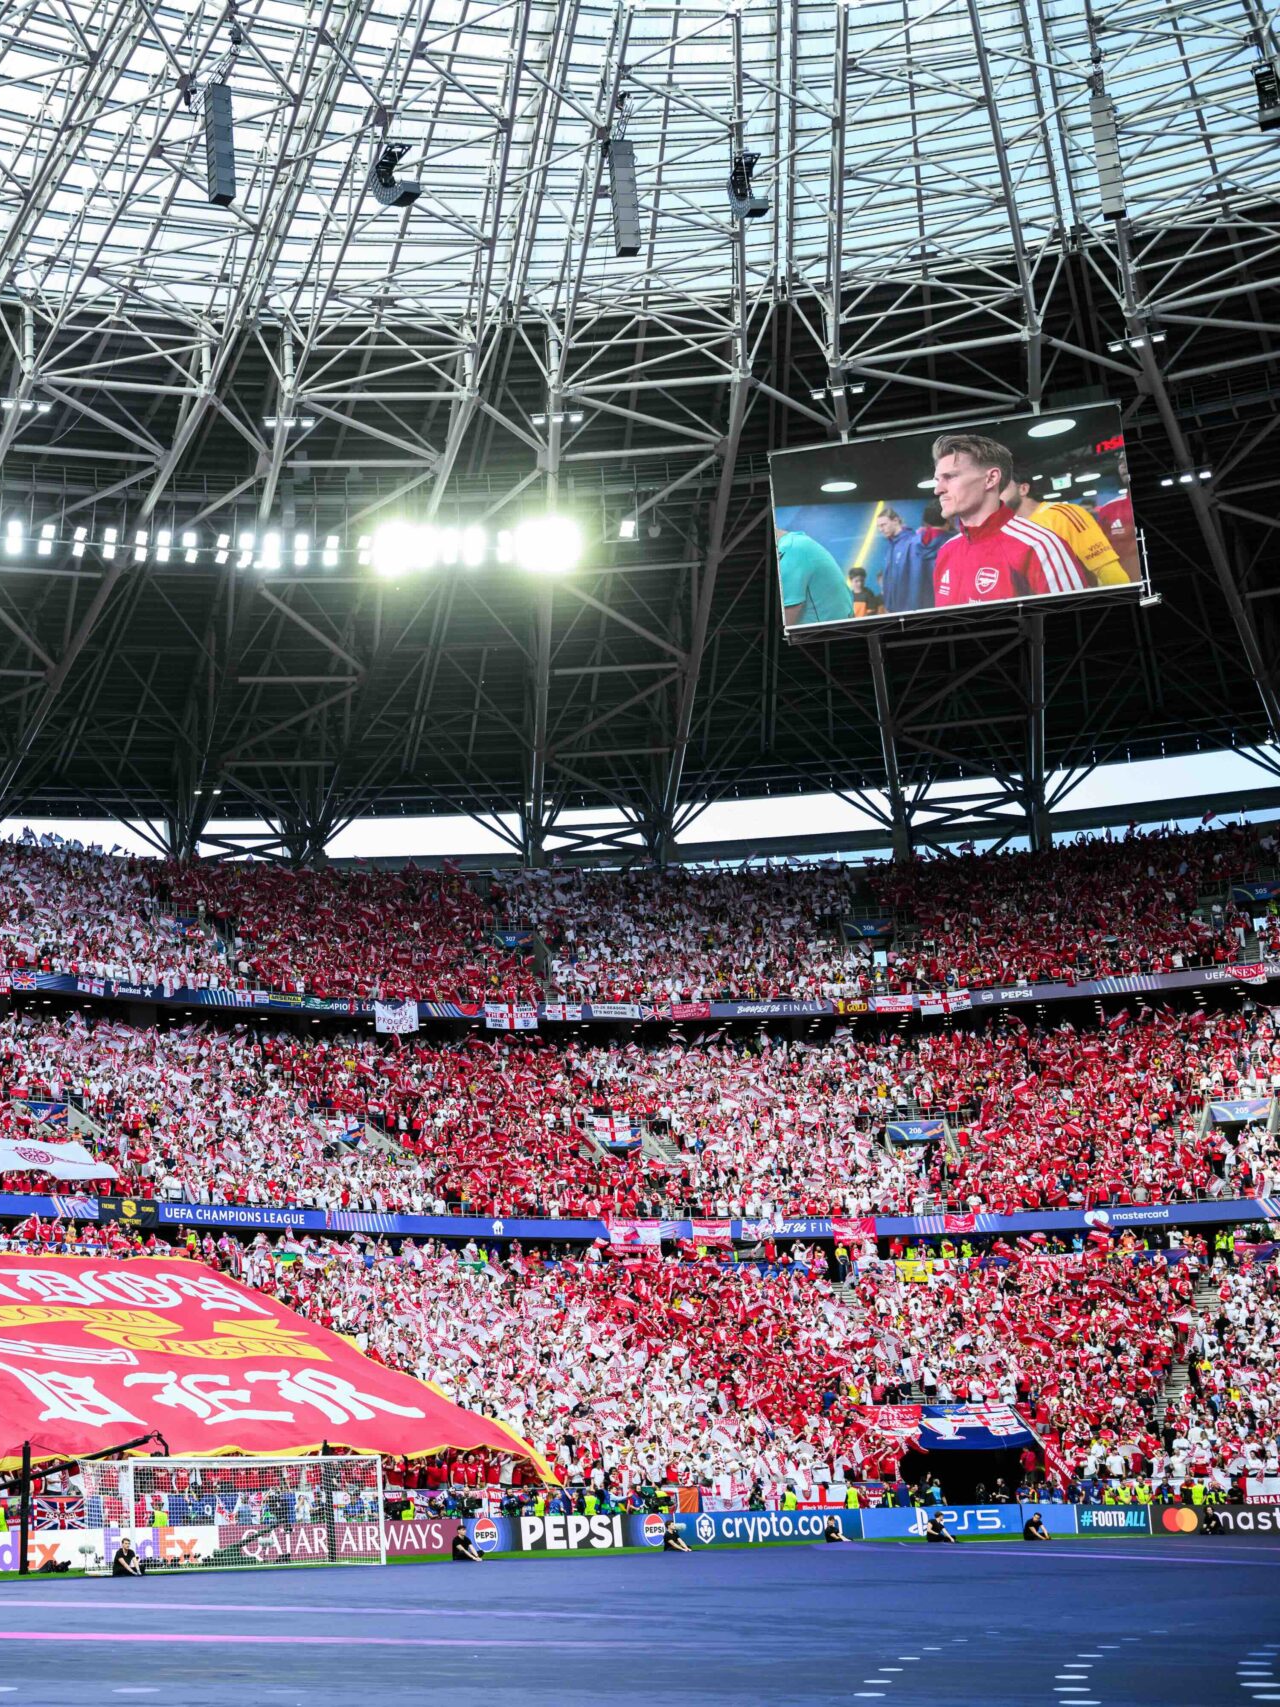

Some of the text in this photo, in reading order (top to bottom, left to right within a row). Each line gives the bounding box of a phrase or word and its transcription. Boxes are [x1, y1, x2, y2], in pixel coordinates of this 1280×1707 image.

[271, 994, 301, 1002] ARSENAL
[937, 994, 967, 1005] ARSENAL
[1001, 989, 1033, 999] PEPSI
[736, 1003, 767, 1015] BUDAPEST
[783, 1002, 814, 1013] FINAL
[847, 1002, 868, 1013] GOLD
[881, 1005, 910, 1013] ARSENAL
[376, 1016, 414, 1025] PROCESS
[502, 1011, 536, 1019] ARSENAL
[1235, 1106, 1249, 1114] 205
[164, 1207, 193, 1219] UEFA
[196, 1208, 261, 1223] CHAMPIONS
[264, 1212, 305, 1225] LEAGUE
[1112, 1209, 1169, 1221] mastercard
[124, 1333, 310, 1358] CRESCIT
[1246, 1494, 1280, 1505] SENAL
[45, 1511, 77, 1520] ARSENAL
[1080, 1510, 1146, 1529] #FOOTBALL
[644, 1525, 665, 1535] PEPSI
[722, 1511, 842, 1542] crypto.com
[475, 1530, 497, 1540] PEPSI
[520, 1514, 623, 1551] PEPSI
[340, 1522, 445, 1556] AIRWAYS
[103, 1527, 199, 1566] FdEx
